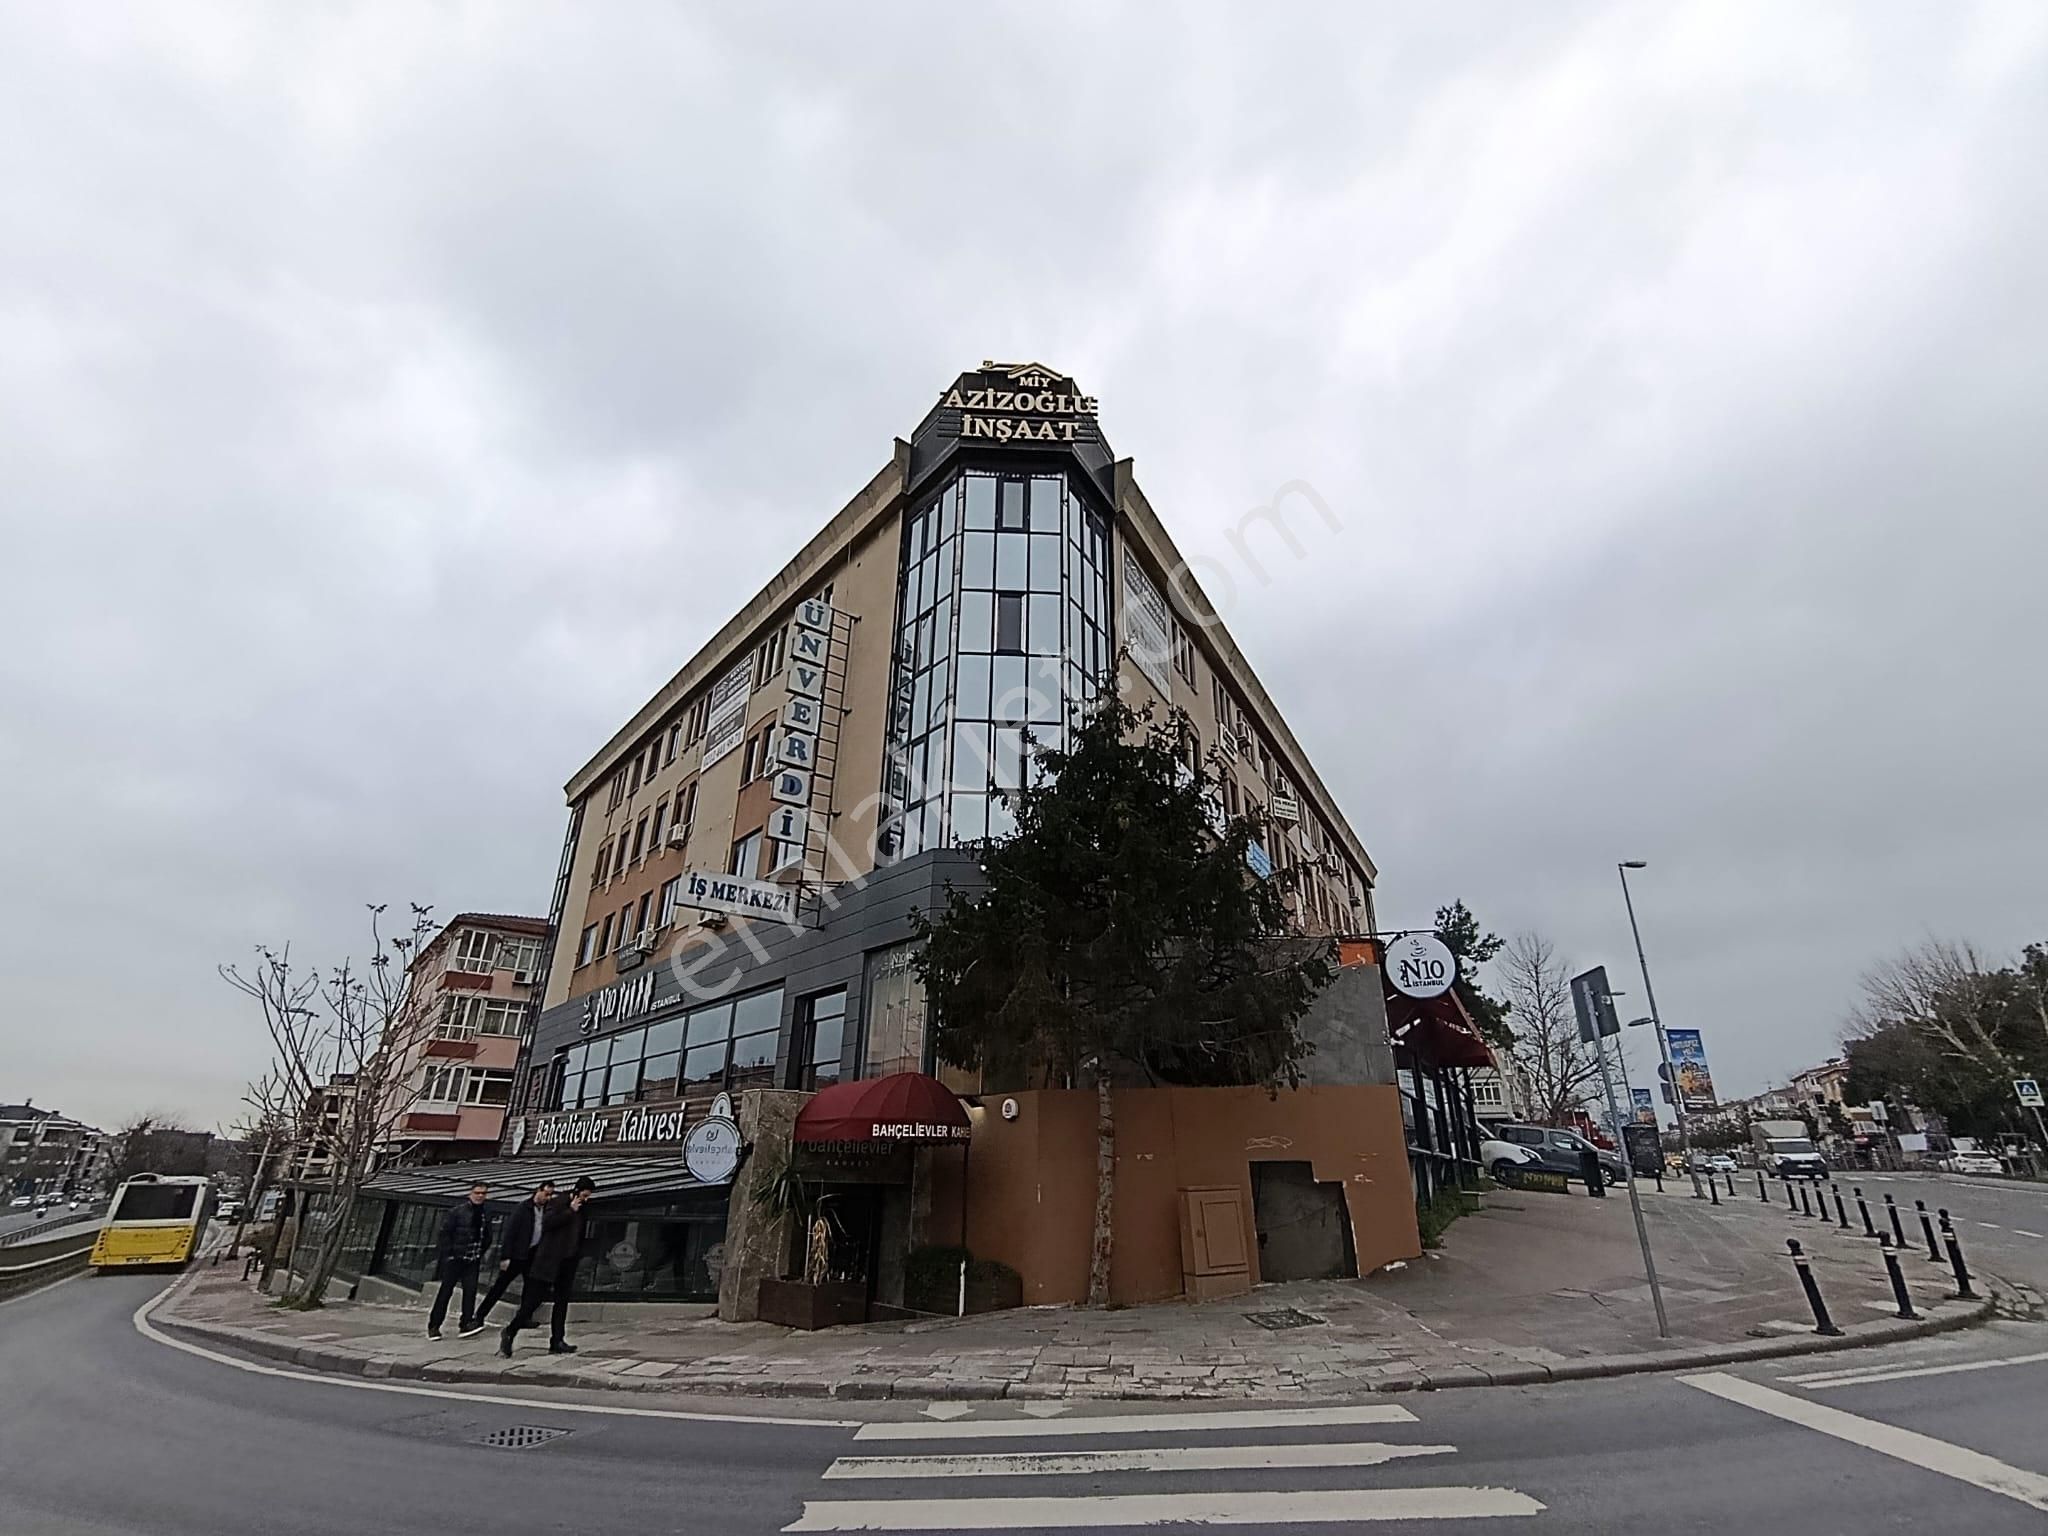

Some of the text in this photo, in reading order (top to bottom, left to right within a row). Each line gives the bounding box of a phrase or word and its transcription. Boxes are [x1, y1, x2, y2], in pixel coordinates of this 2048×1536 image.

[943, 387, 1092, 414] AZİZOĞLU
[961, 414, 1080, 443] İNŞAAT
[779, 601, 824, 837] ÜNVERDİ
[688, 871, 791, 913] İŞ MERKEZİ
[533, 1101, 686, 1152] Bahçelievler Kahvesi
[872, 1122, 948, 1140] BAHÇELİEVLER
